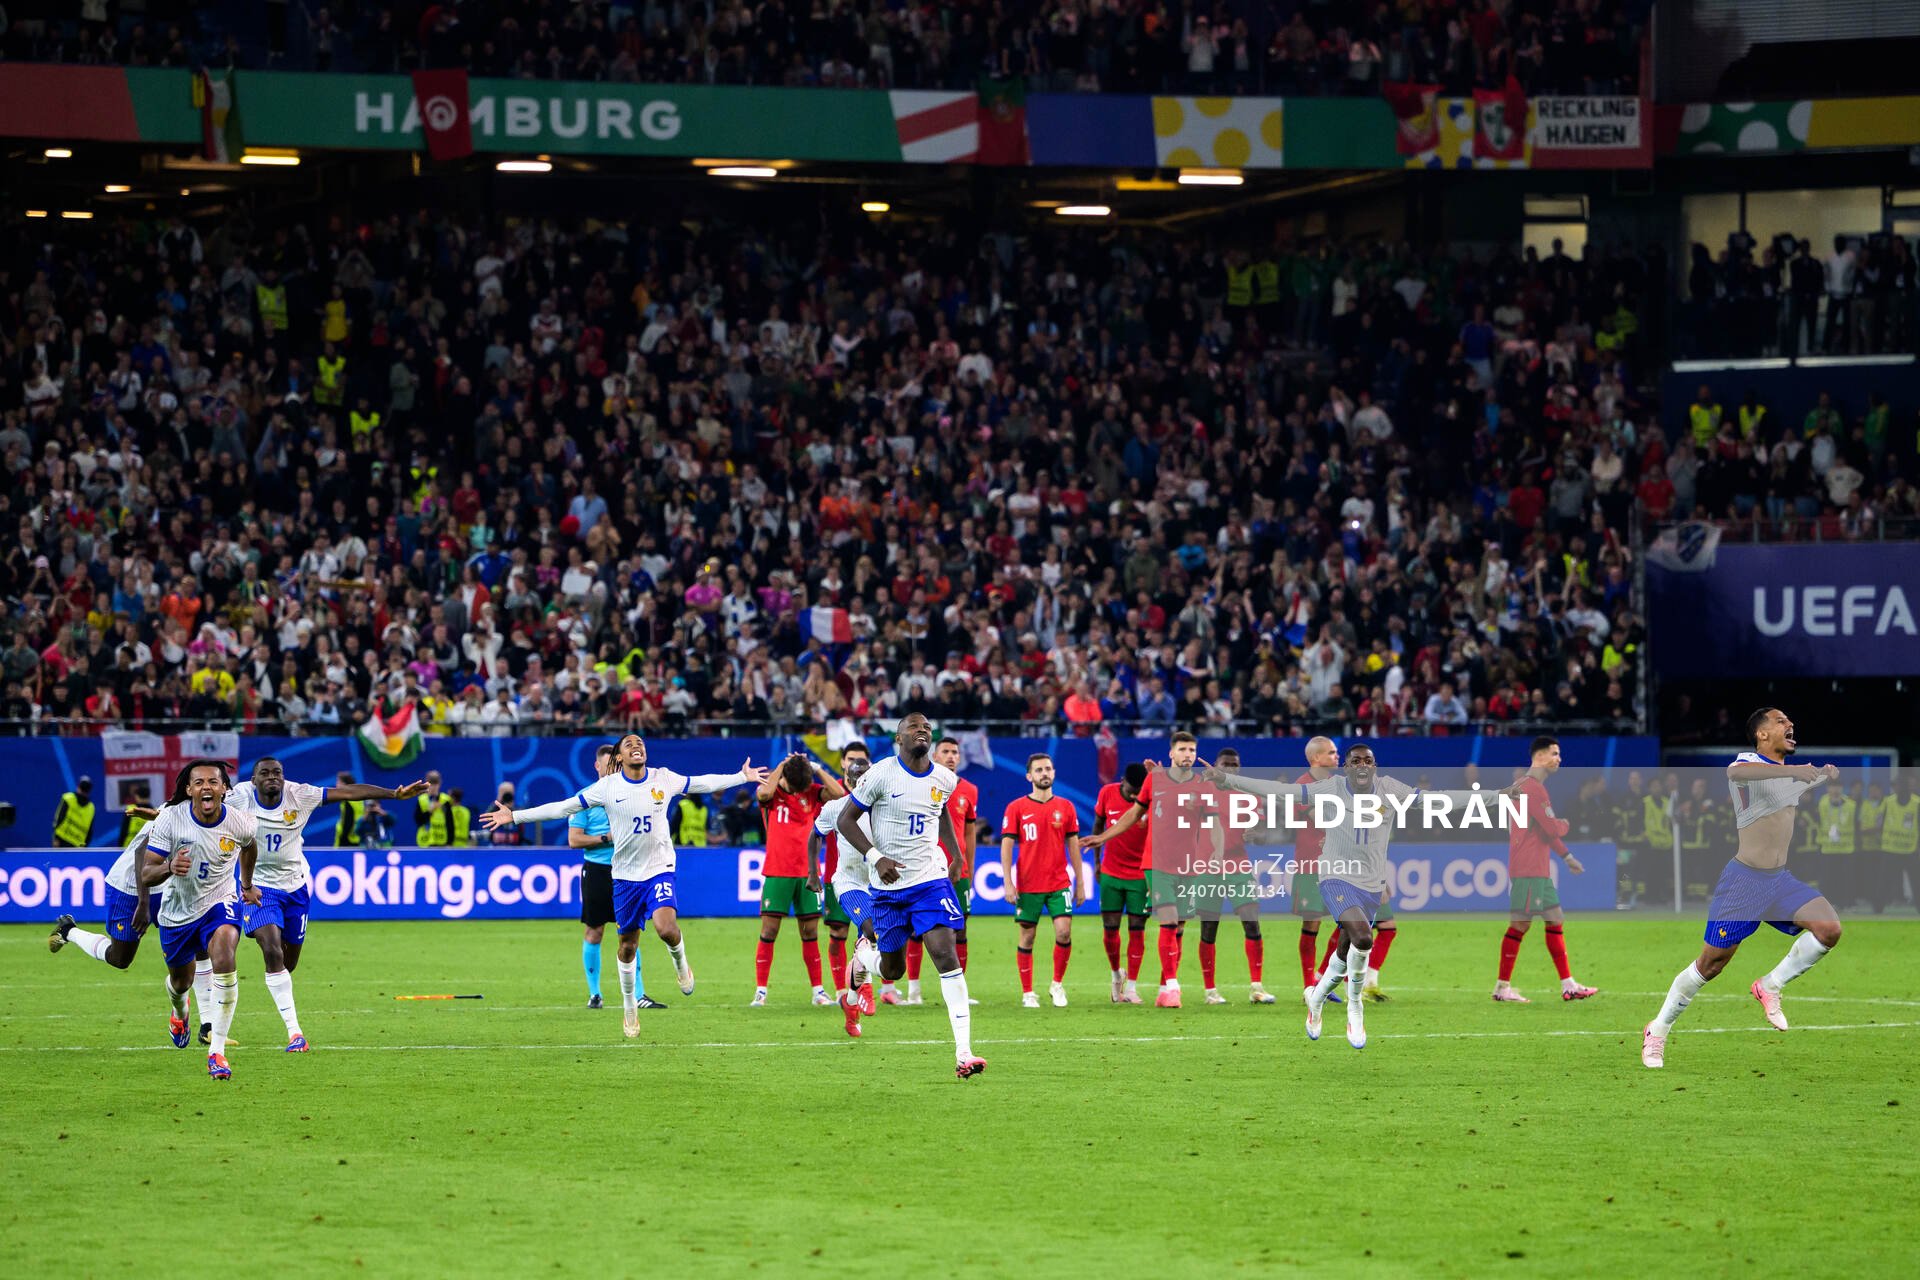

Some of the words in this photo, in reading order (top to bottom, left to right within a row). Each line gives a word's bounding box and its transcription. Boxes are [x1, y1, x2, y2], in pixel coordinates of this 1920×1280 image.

[1538, 100, 1636, 118] RECKLING
[1546, 125, 1626, 144] HAUSEN
[1753, 585, 1919, 637] UEFA
[776, 805, 790, 824] 11
[633, 815, 652, 834] 25
[908, 814, 926, 836] 15
[1022, 822, 1038, 841] 10
[265, 833, 283, 852] 19
[198, 862, 209, 879] 5
[0, 866, 106, 908] om
[304, 851, 584, 919] oking.co
[654, 882, 673, 899] 25
[223, 901, 236, 918] 5
